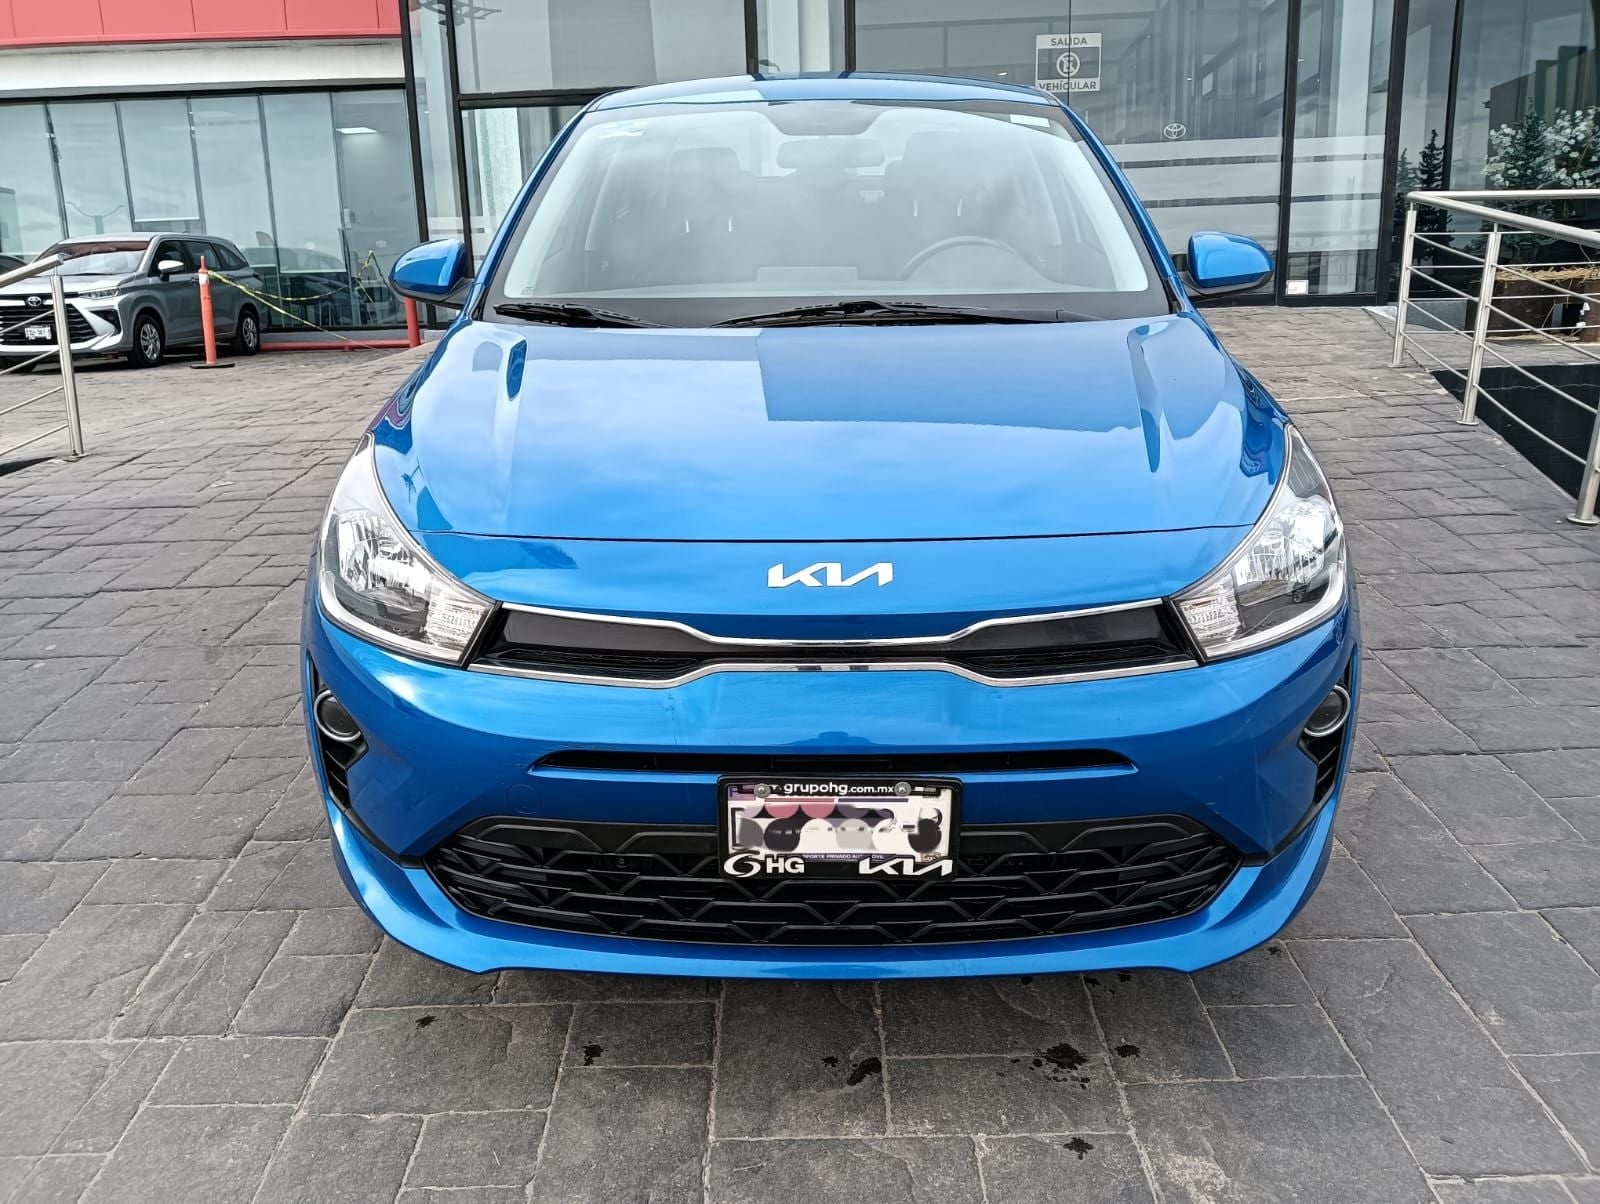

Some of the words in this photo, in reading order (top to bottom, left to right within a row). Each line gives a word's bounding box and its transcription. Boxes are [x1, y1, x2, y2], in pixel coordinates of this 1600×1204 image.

[1051, 37, 1088, 46] SALIDA
[767, 562, 894, 588] KIA
[766, 857, 805, 874] HG
[858, 857, 953, 876] KIA
